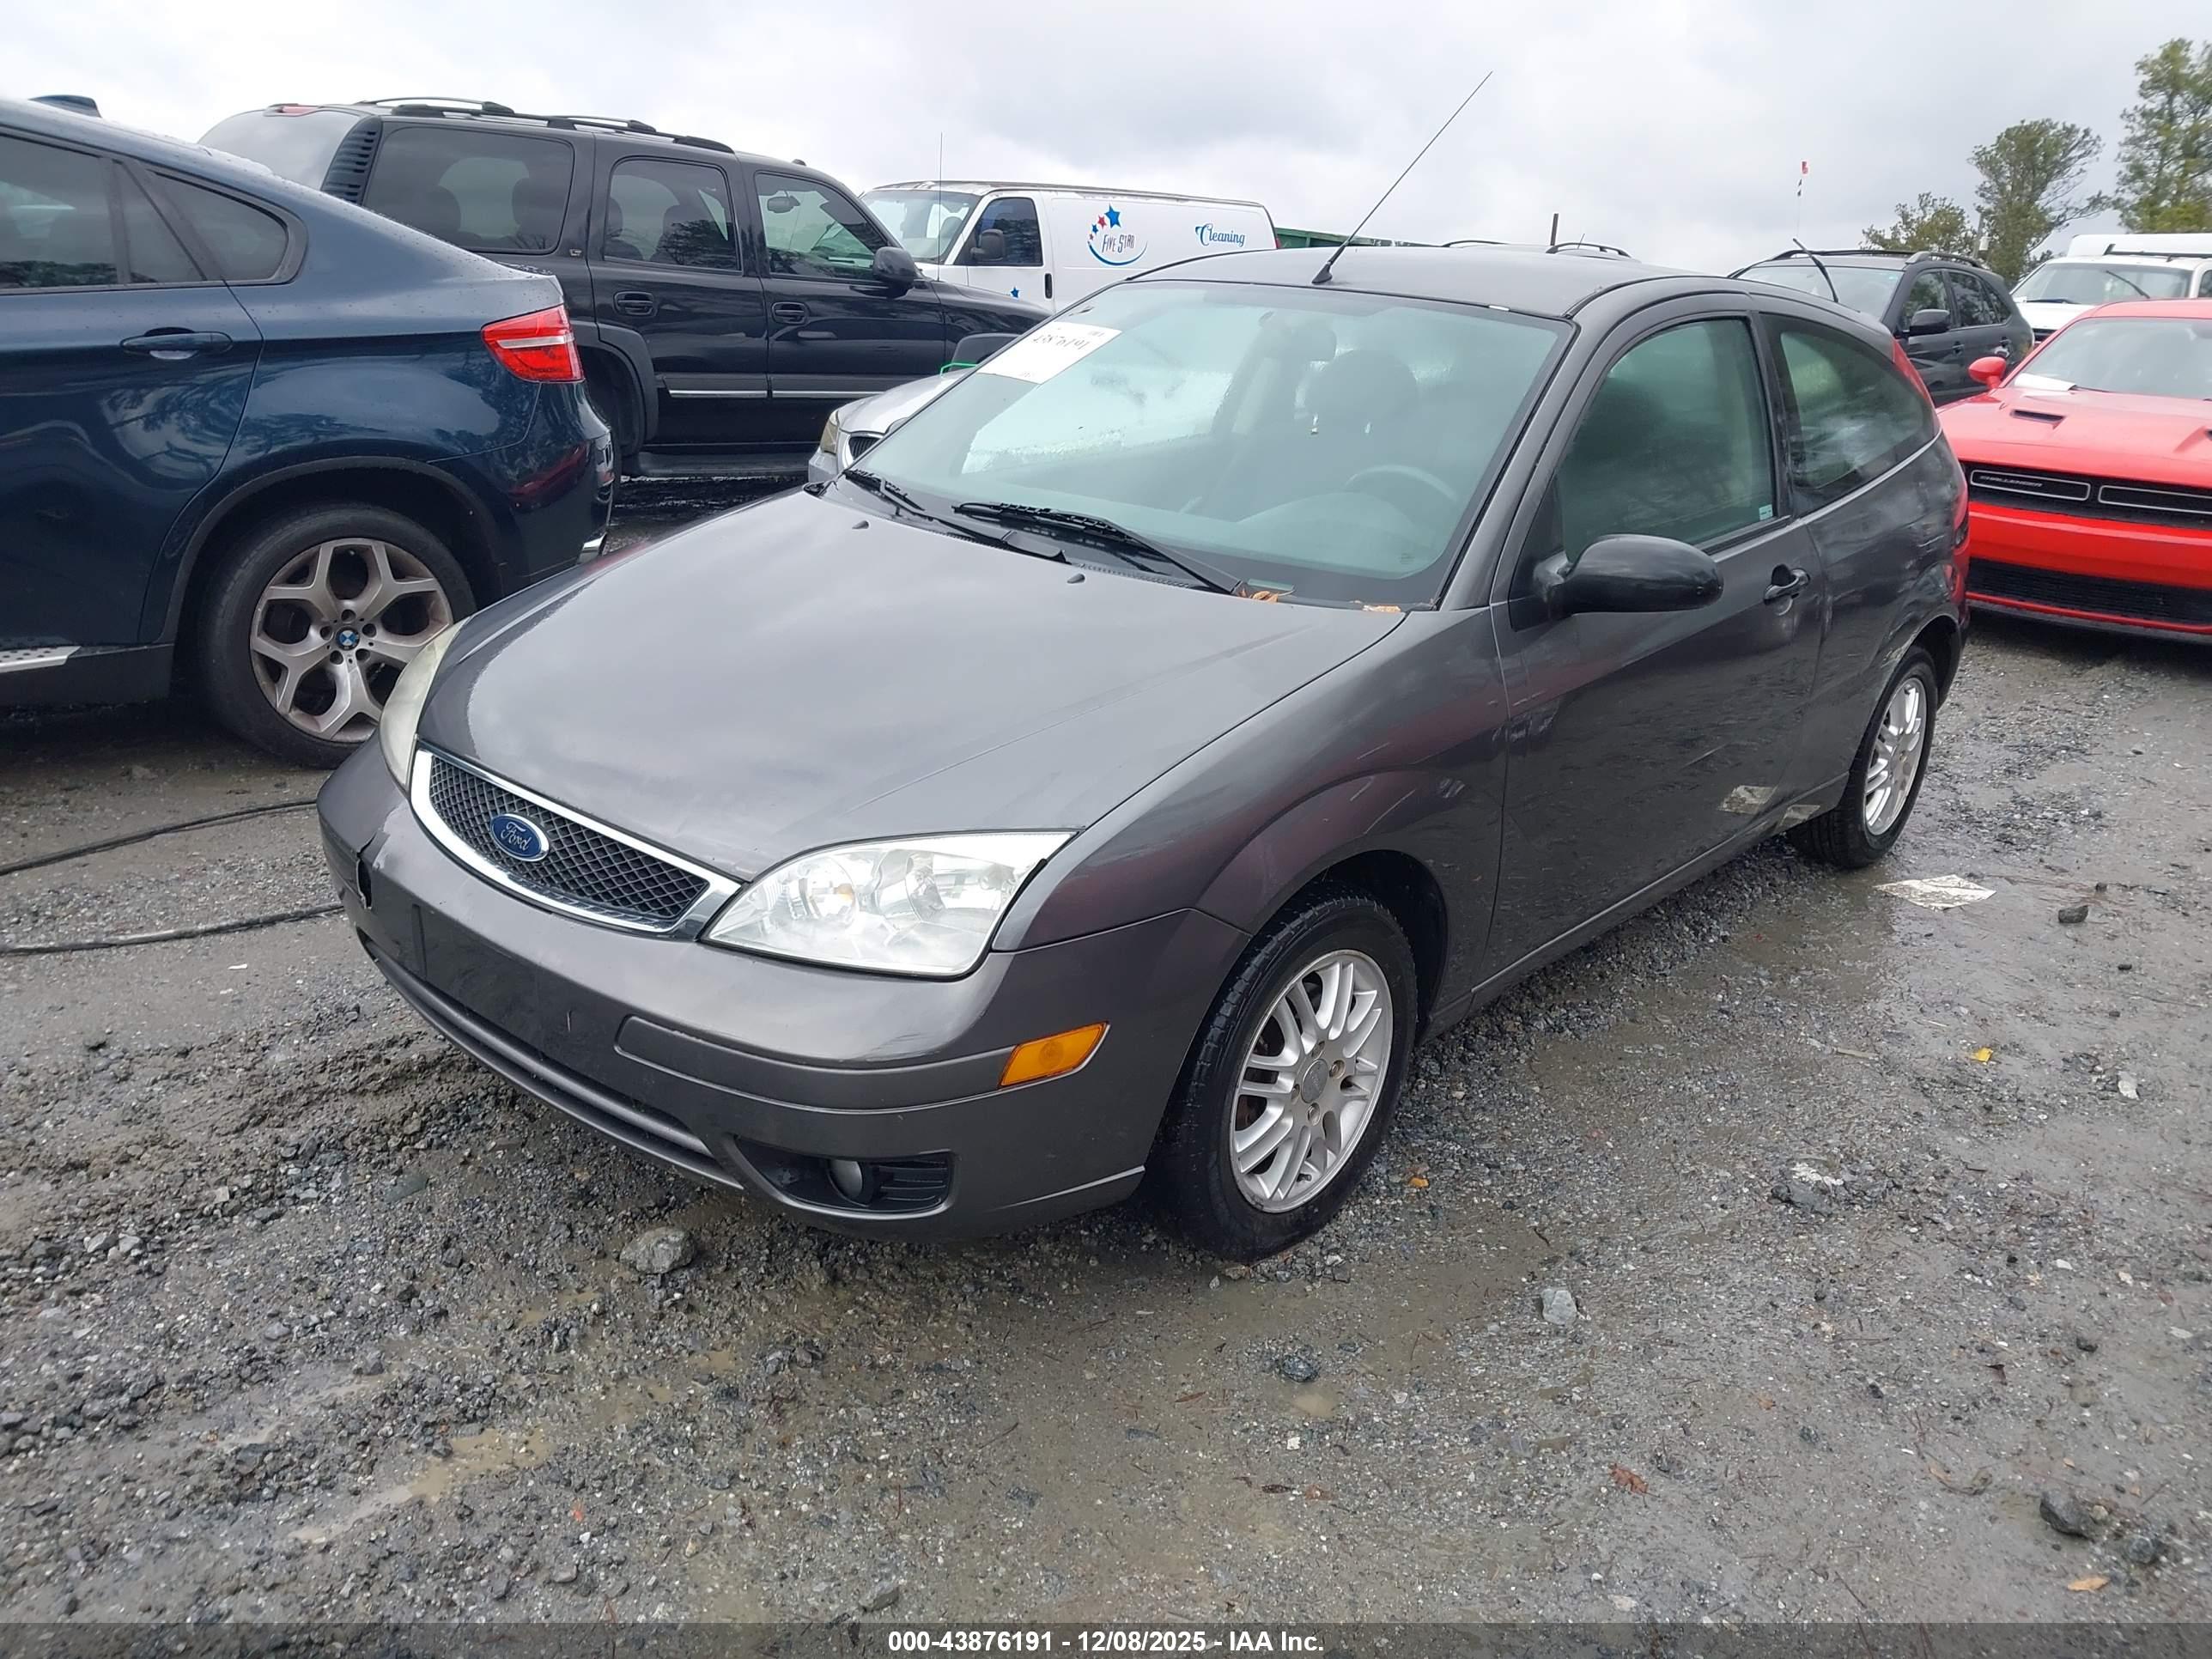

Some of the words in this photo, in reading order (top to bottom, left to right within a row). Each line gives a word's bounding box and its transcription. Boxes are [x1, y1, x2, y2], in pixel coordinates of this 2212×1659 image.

[1102, 234, 1116, 253] FIVE
[1117, 234, 1135, 253] STAR
[1194, 222, 1245, 247] Cleaning
[1979, 475, 2042, 487] CHALLENGER
[501, 822, 532, 851] Ford
